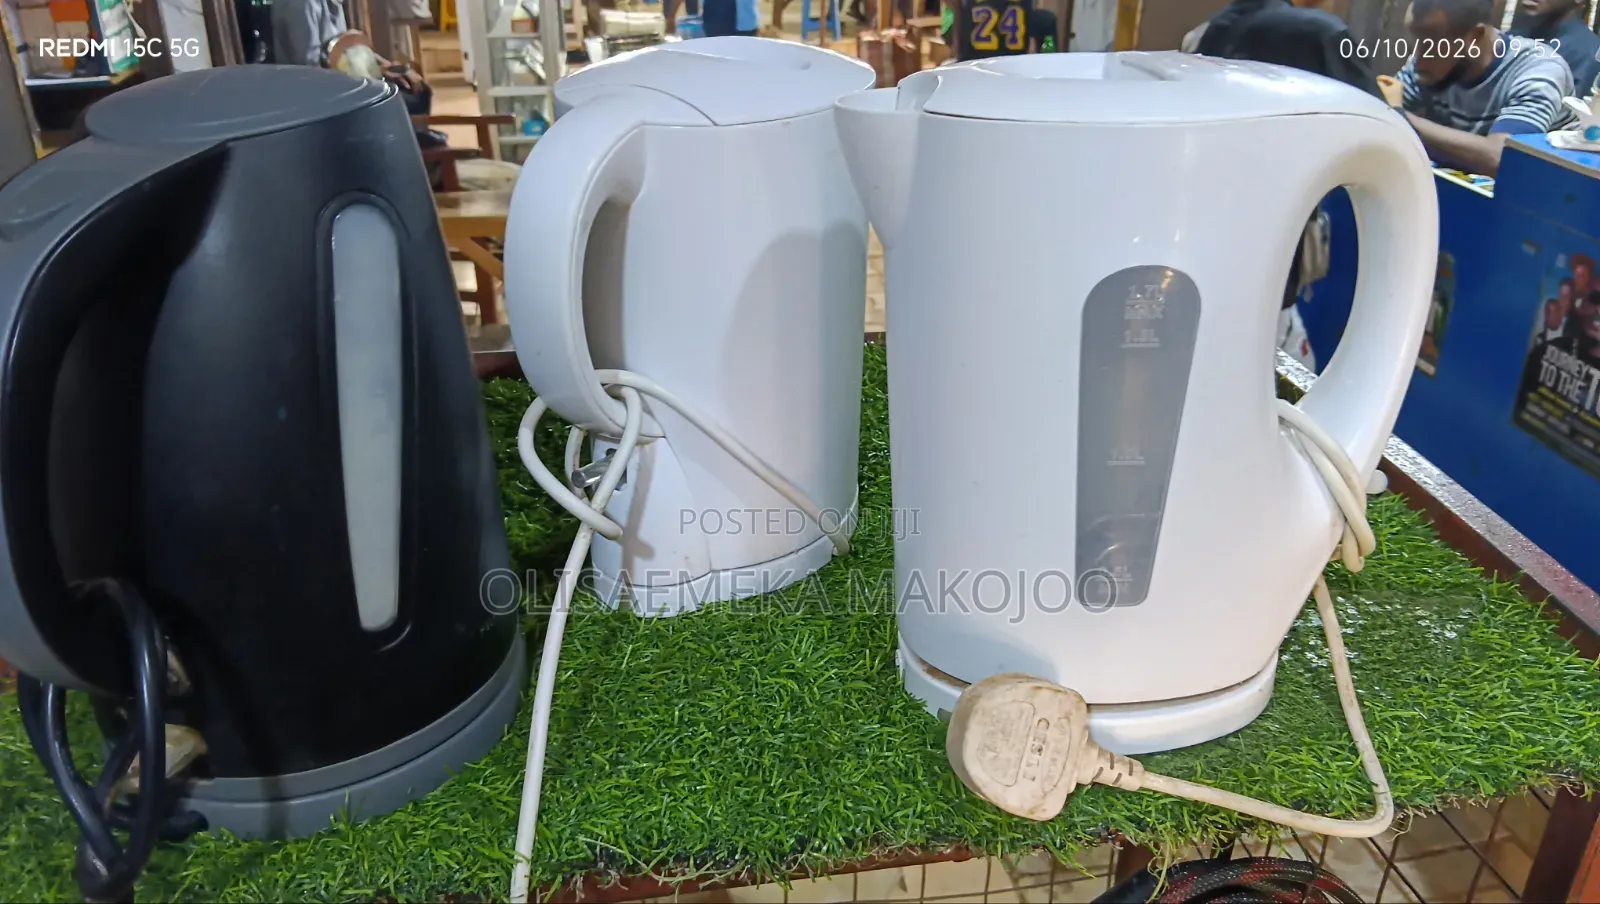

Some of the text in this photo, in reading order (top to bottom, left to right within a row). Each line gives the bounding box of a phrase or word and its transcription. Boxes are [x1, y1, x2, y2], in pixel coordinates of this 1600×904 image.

[971, 6, 1026, 50] 24
[1539, 360, 1588, 404] TO THE
